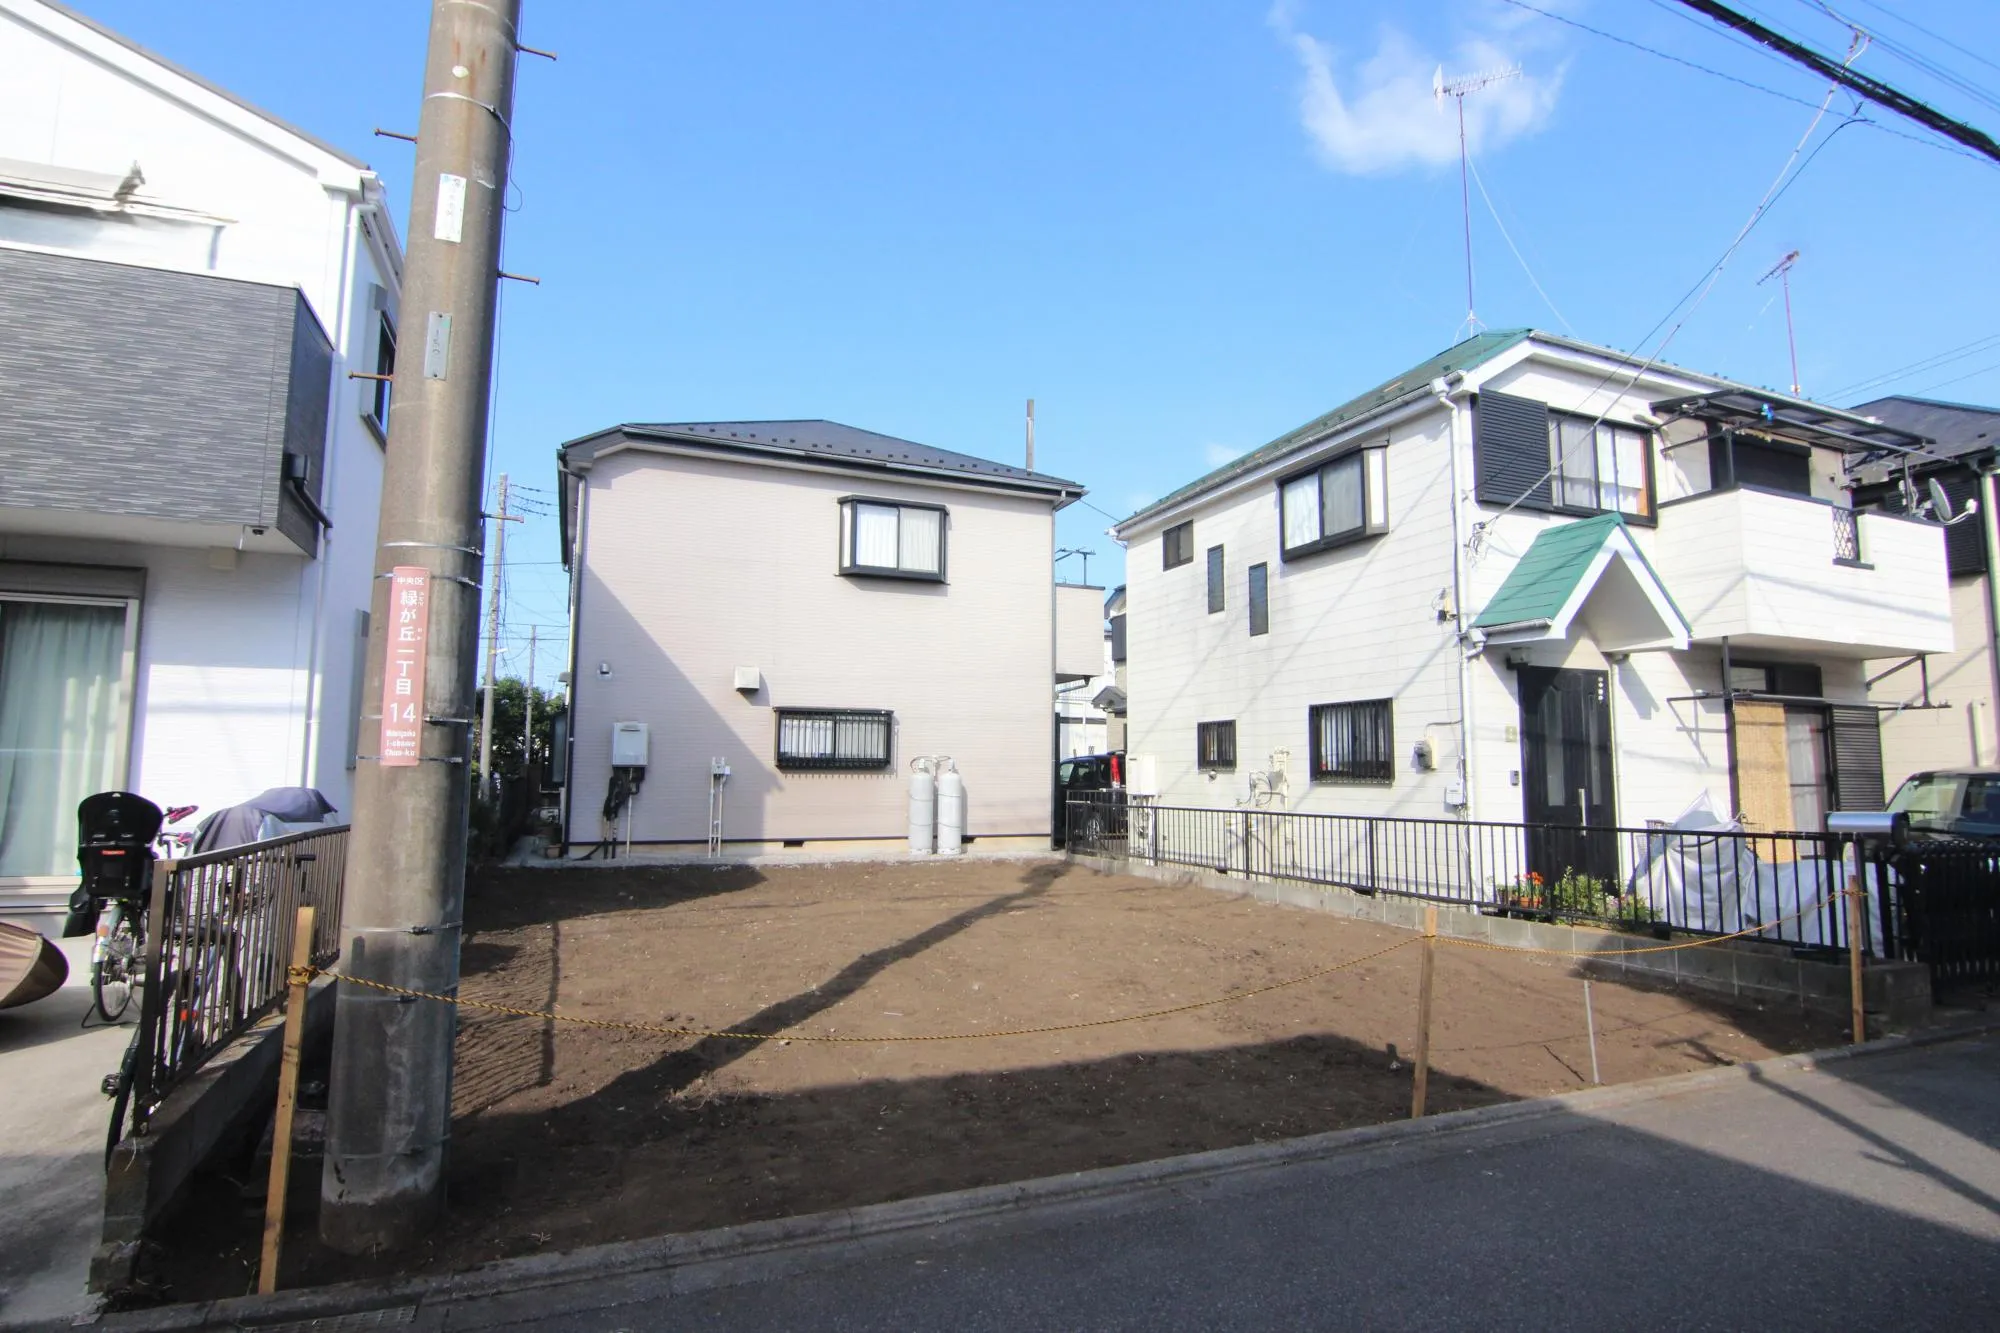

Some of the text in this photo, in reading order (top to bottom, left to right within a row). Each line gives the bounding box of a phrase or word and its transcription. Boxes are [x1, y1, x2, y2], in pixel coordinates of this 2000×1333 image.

[397, 576, 424, 586] 中央区
[389, 589, 418, 723] 緑が丘一丁目 14
